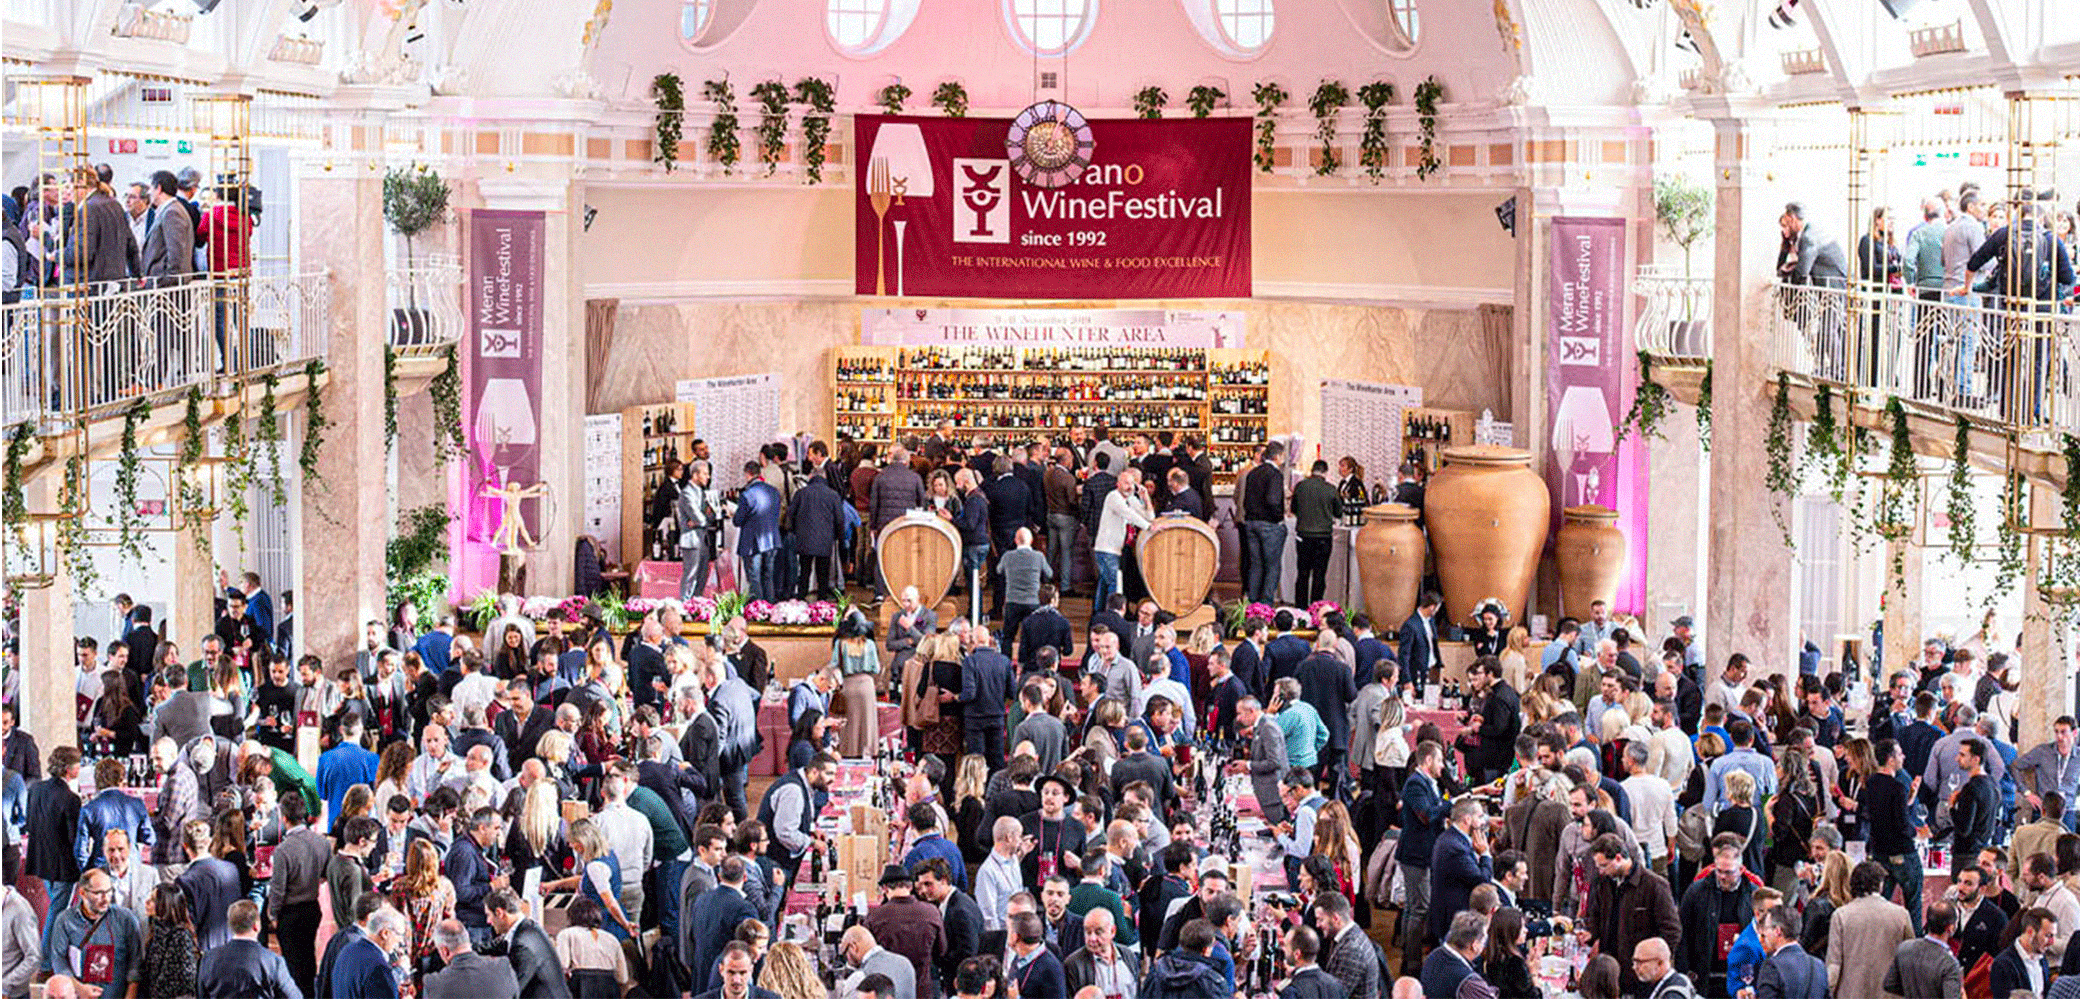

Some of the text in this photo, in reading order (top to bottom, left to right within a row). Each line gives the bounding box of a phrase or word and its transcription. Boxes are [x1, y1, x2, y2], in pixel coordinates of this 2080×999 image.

[1021, 187, 1222, 219] WineFestival
[1021, 231, 1107, 246] since 1992
[496, 227, 511, 324] WineFestival
[952, 255, 1221, 269] THE INTERNATIONAL WINE & FOOD EXCELLENCE
[480, 275, 494, 324] Meran
[1575, 234, 1591, 331] WineFestival
[1559, 281, 1574, 331] Meran
[940, 325, 1167, 342] THE WINEHUNTER AREA
